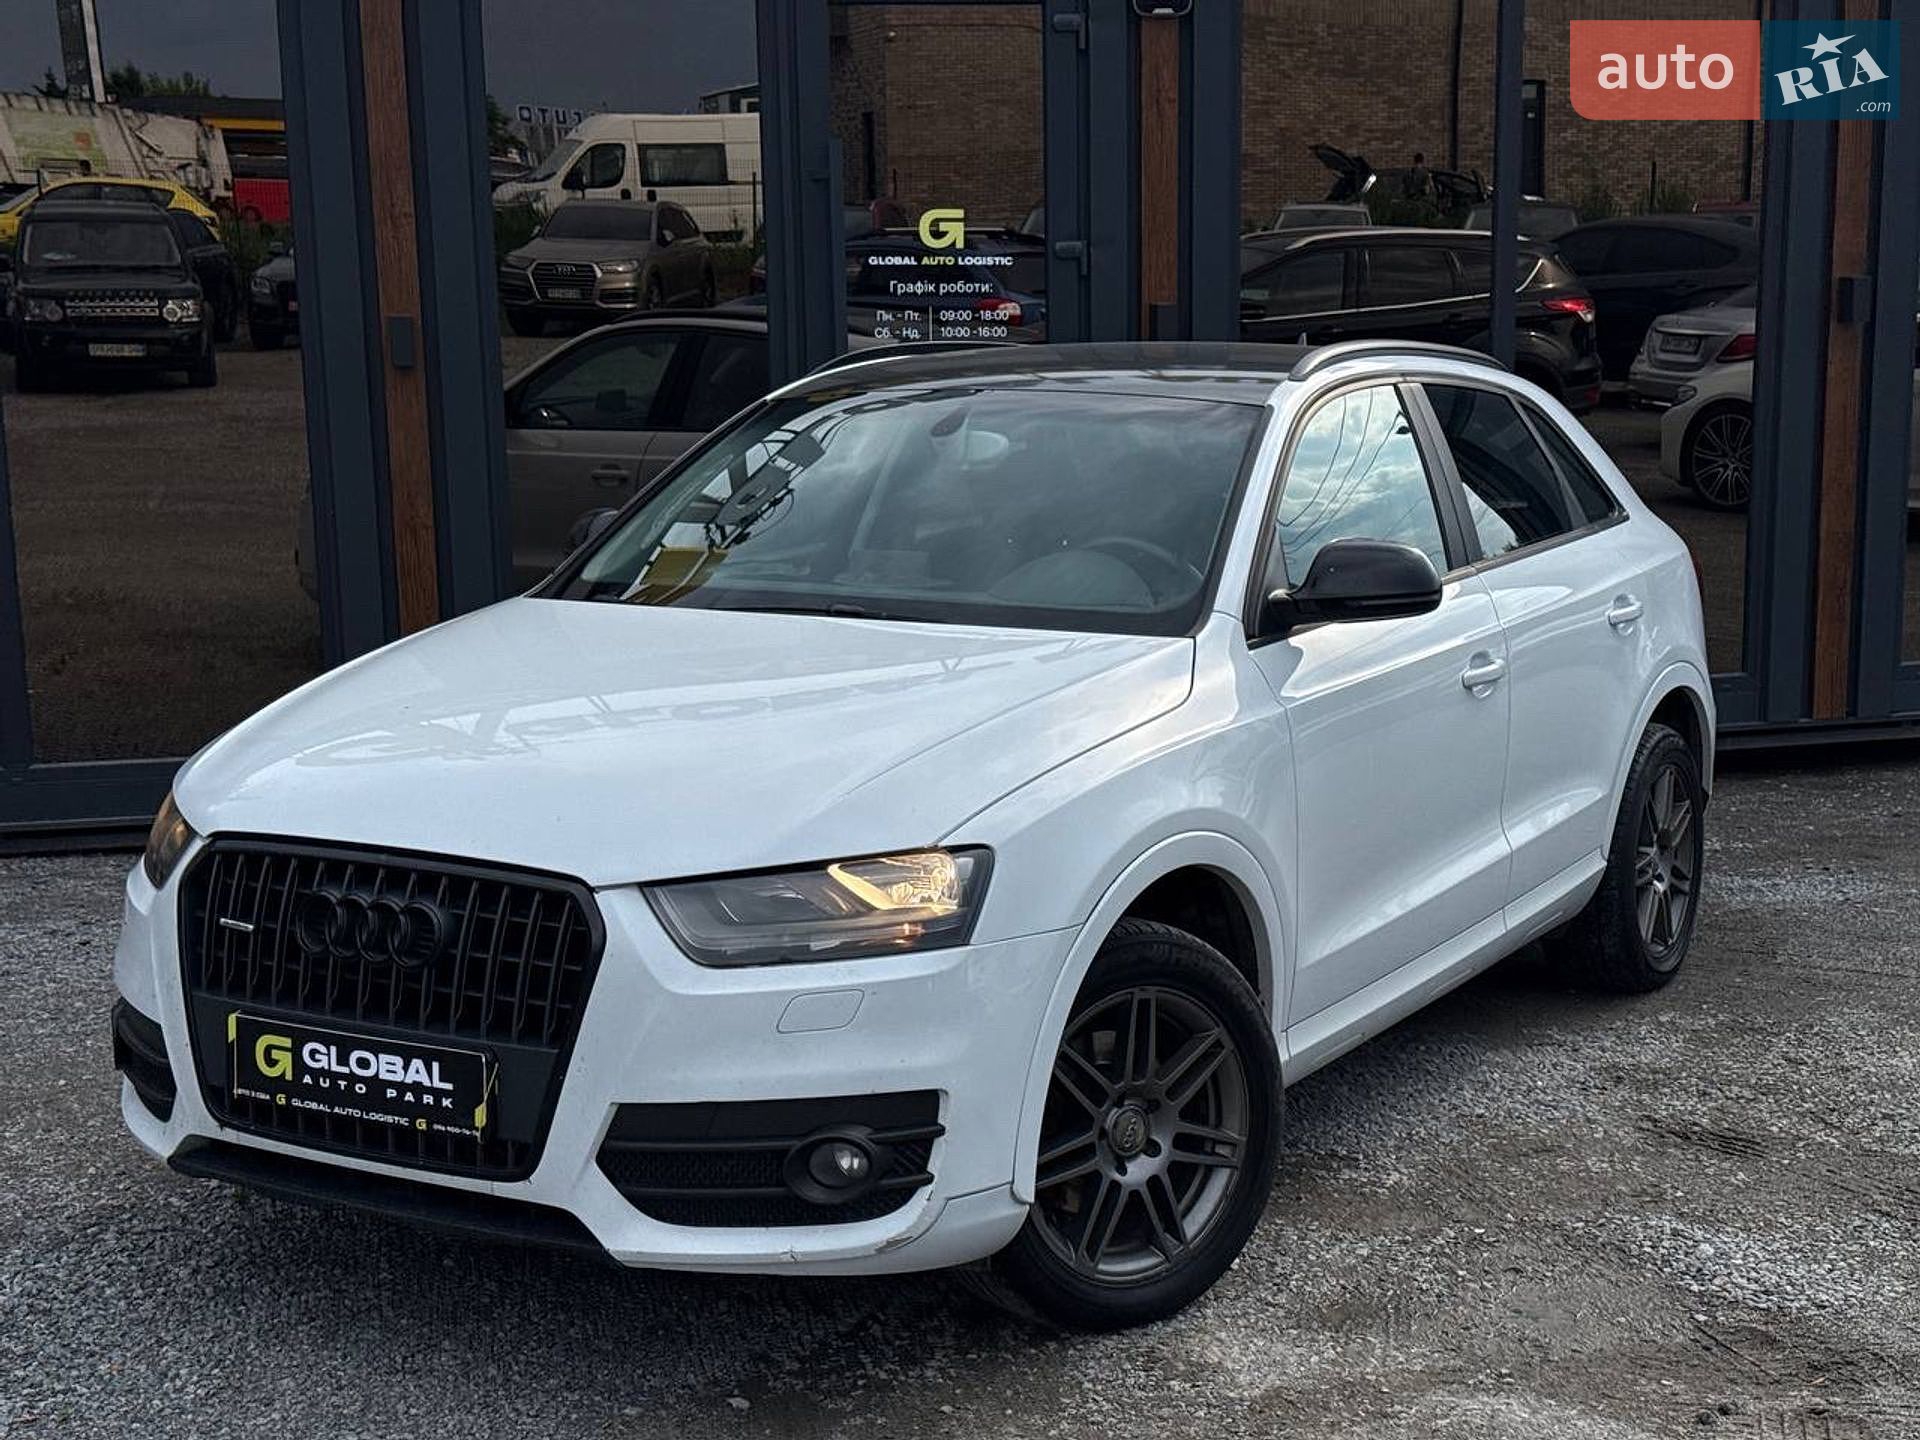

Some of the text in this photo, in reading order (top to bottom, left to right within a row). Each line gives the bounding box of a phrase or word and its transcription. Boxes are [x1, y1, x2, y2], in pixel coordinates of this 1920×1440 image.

[868, 256, 1013, 266] GLOBAL AUTO LOGISTIC
[889, 280, 994, 295] Графік роботи:
[302, 1041, 454, 1090] GLOBAL
[302, 1074, 454, 1109] AUTO PARK
[291, 1097, 331, 1113] GLOBAL
[333, 1105, 361, 1118] AUTO
[363, 1110, 410, 1126] LOGISTIC
